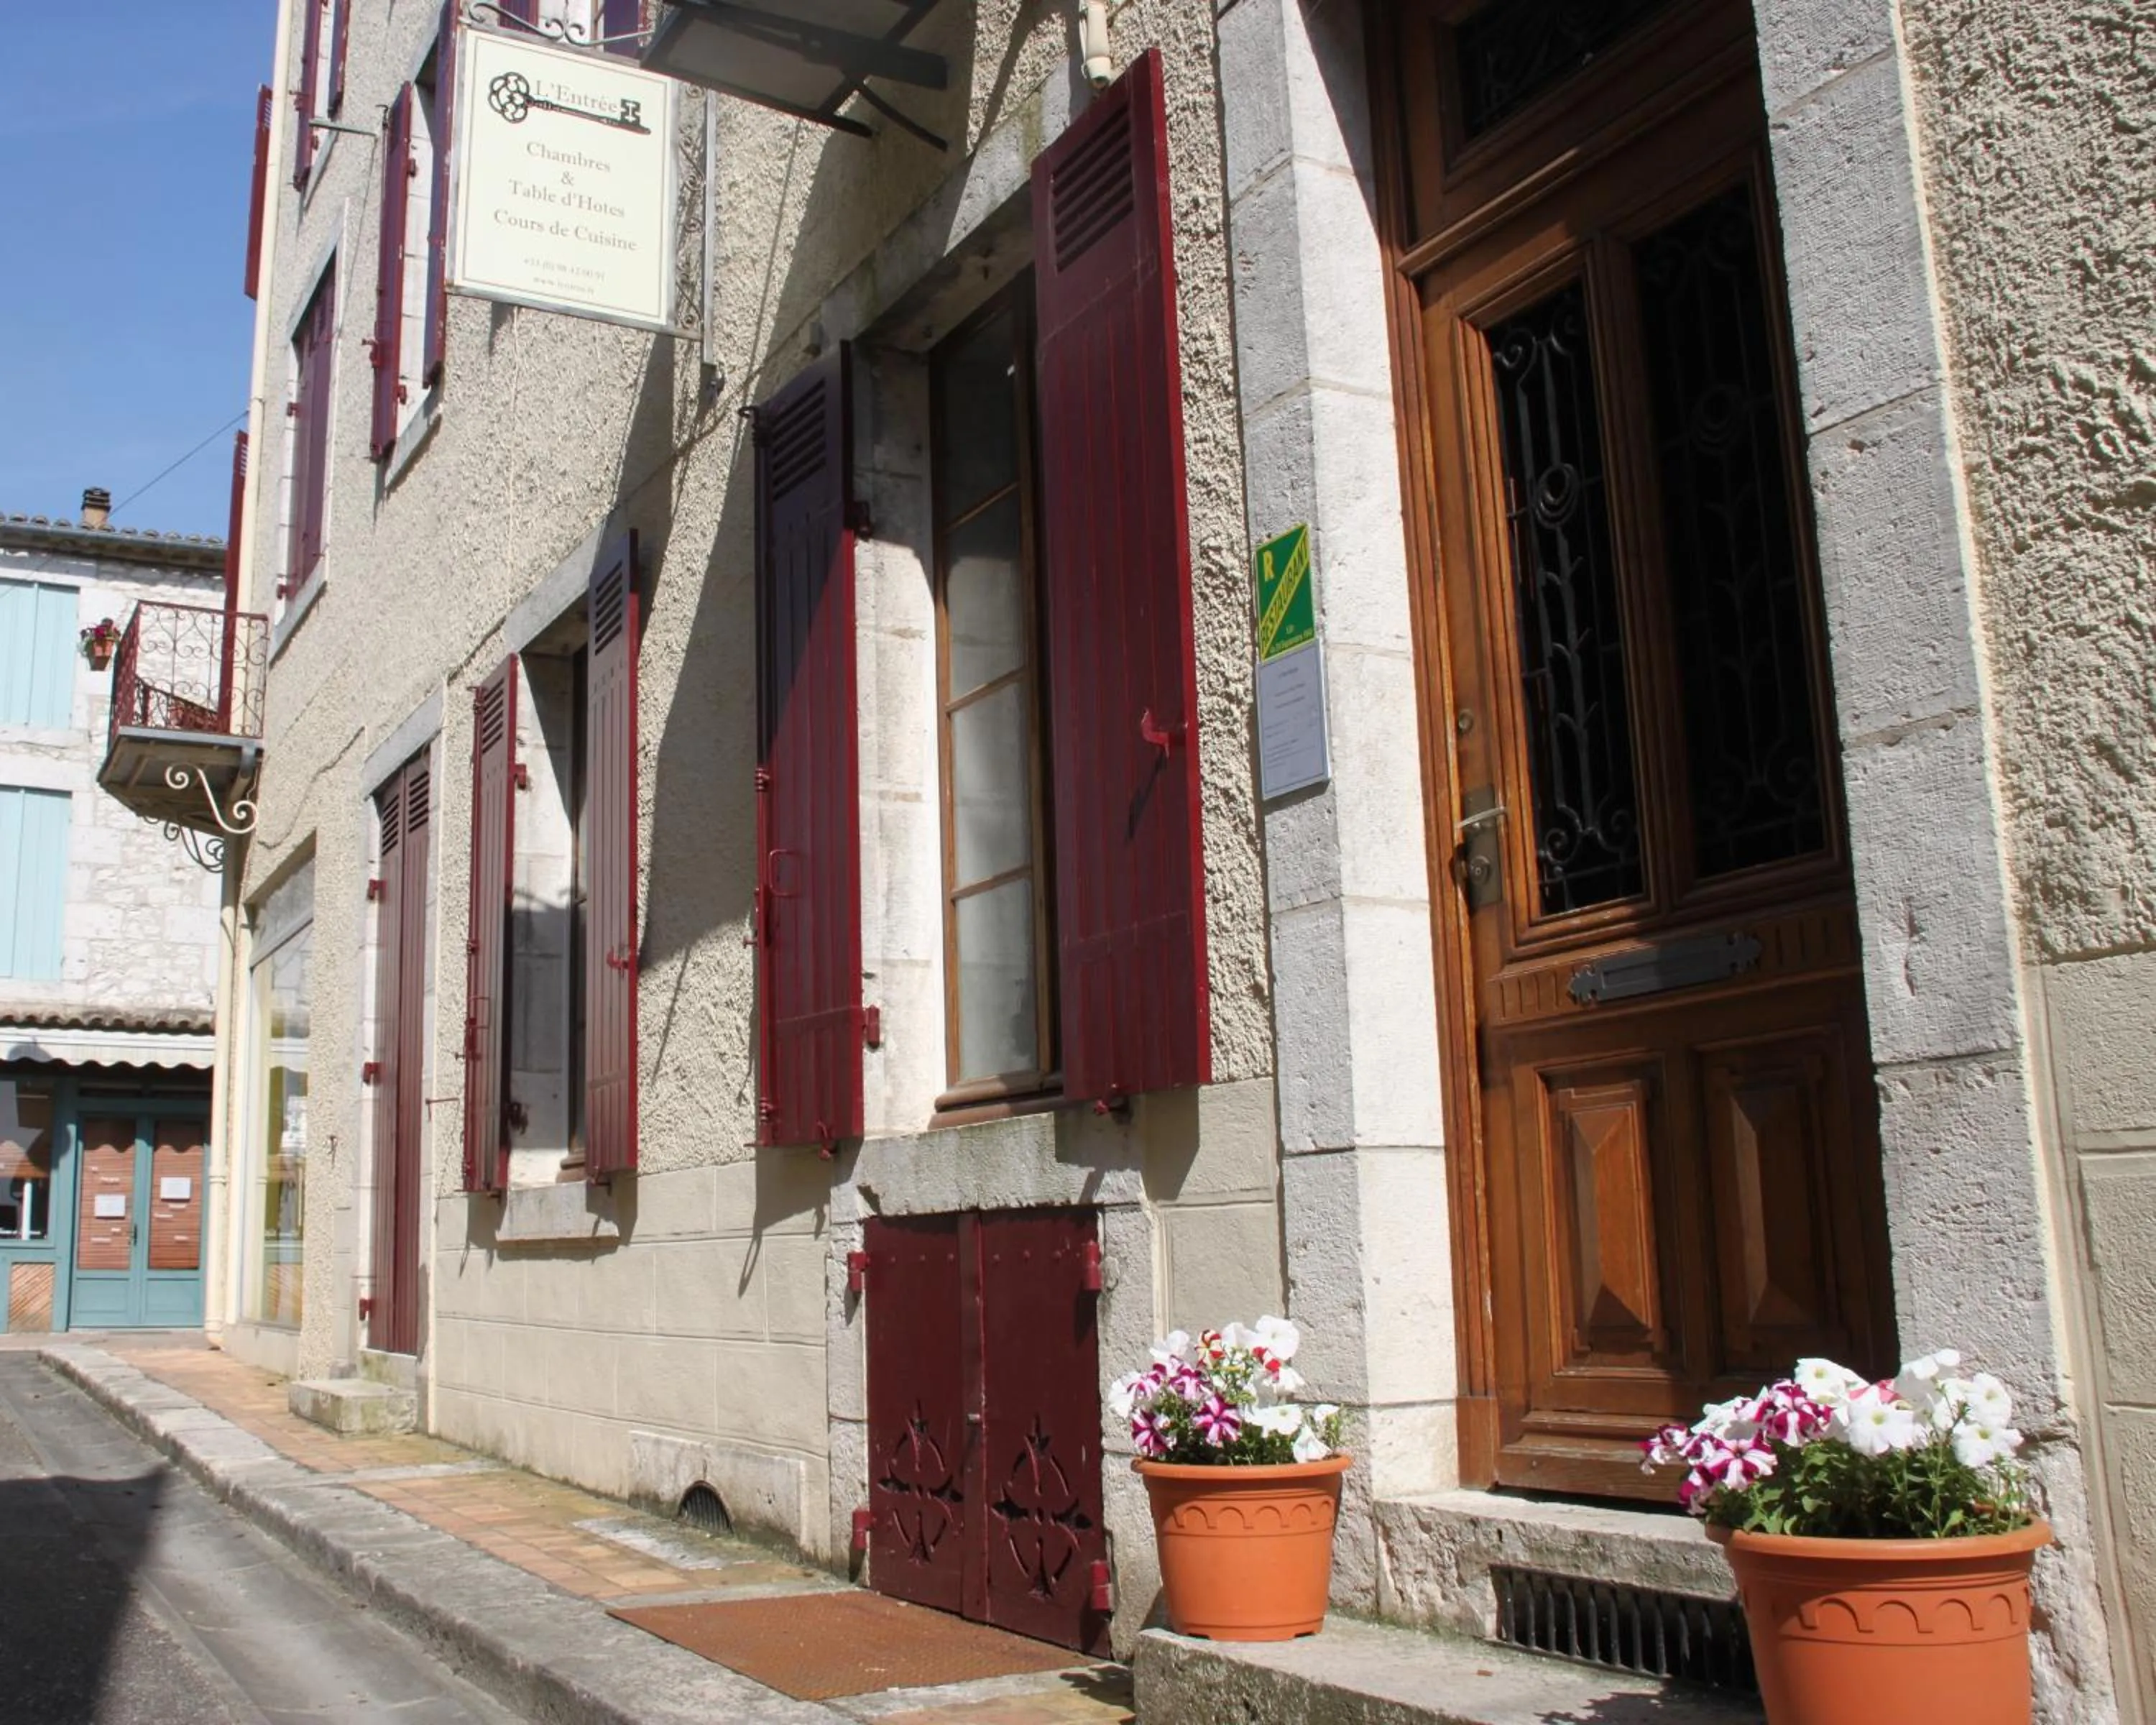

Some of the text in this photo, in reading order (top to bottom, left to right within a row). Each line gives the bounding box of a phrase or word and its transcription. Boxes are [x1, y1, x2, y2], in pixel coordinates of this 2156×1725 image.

[535, 79, 619, 114] L'Entrée
[526, 141, 611, 172] Chambres
[508, 178, 556, 203] Table
[561, 170, 575, 186] &
[494, 208, 637, 252] Cours de Cuisine
[1263, 550, 1275, 581] R
